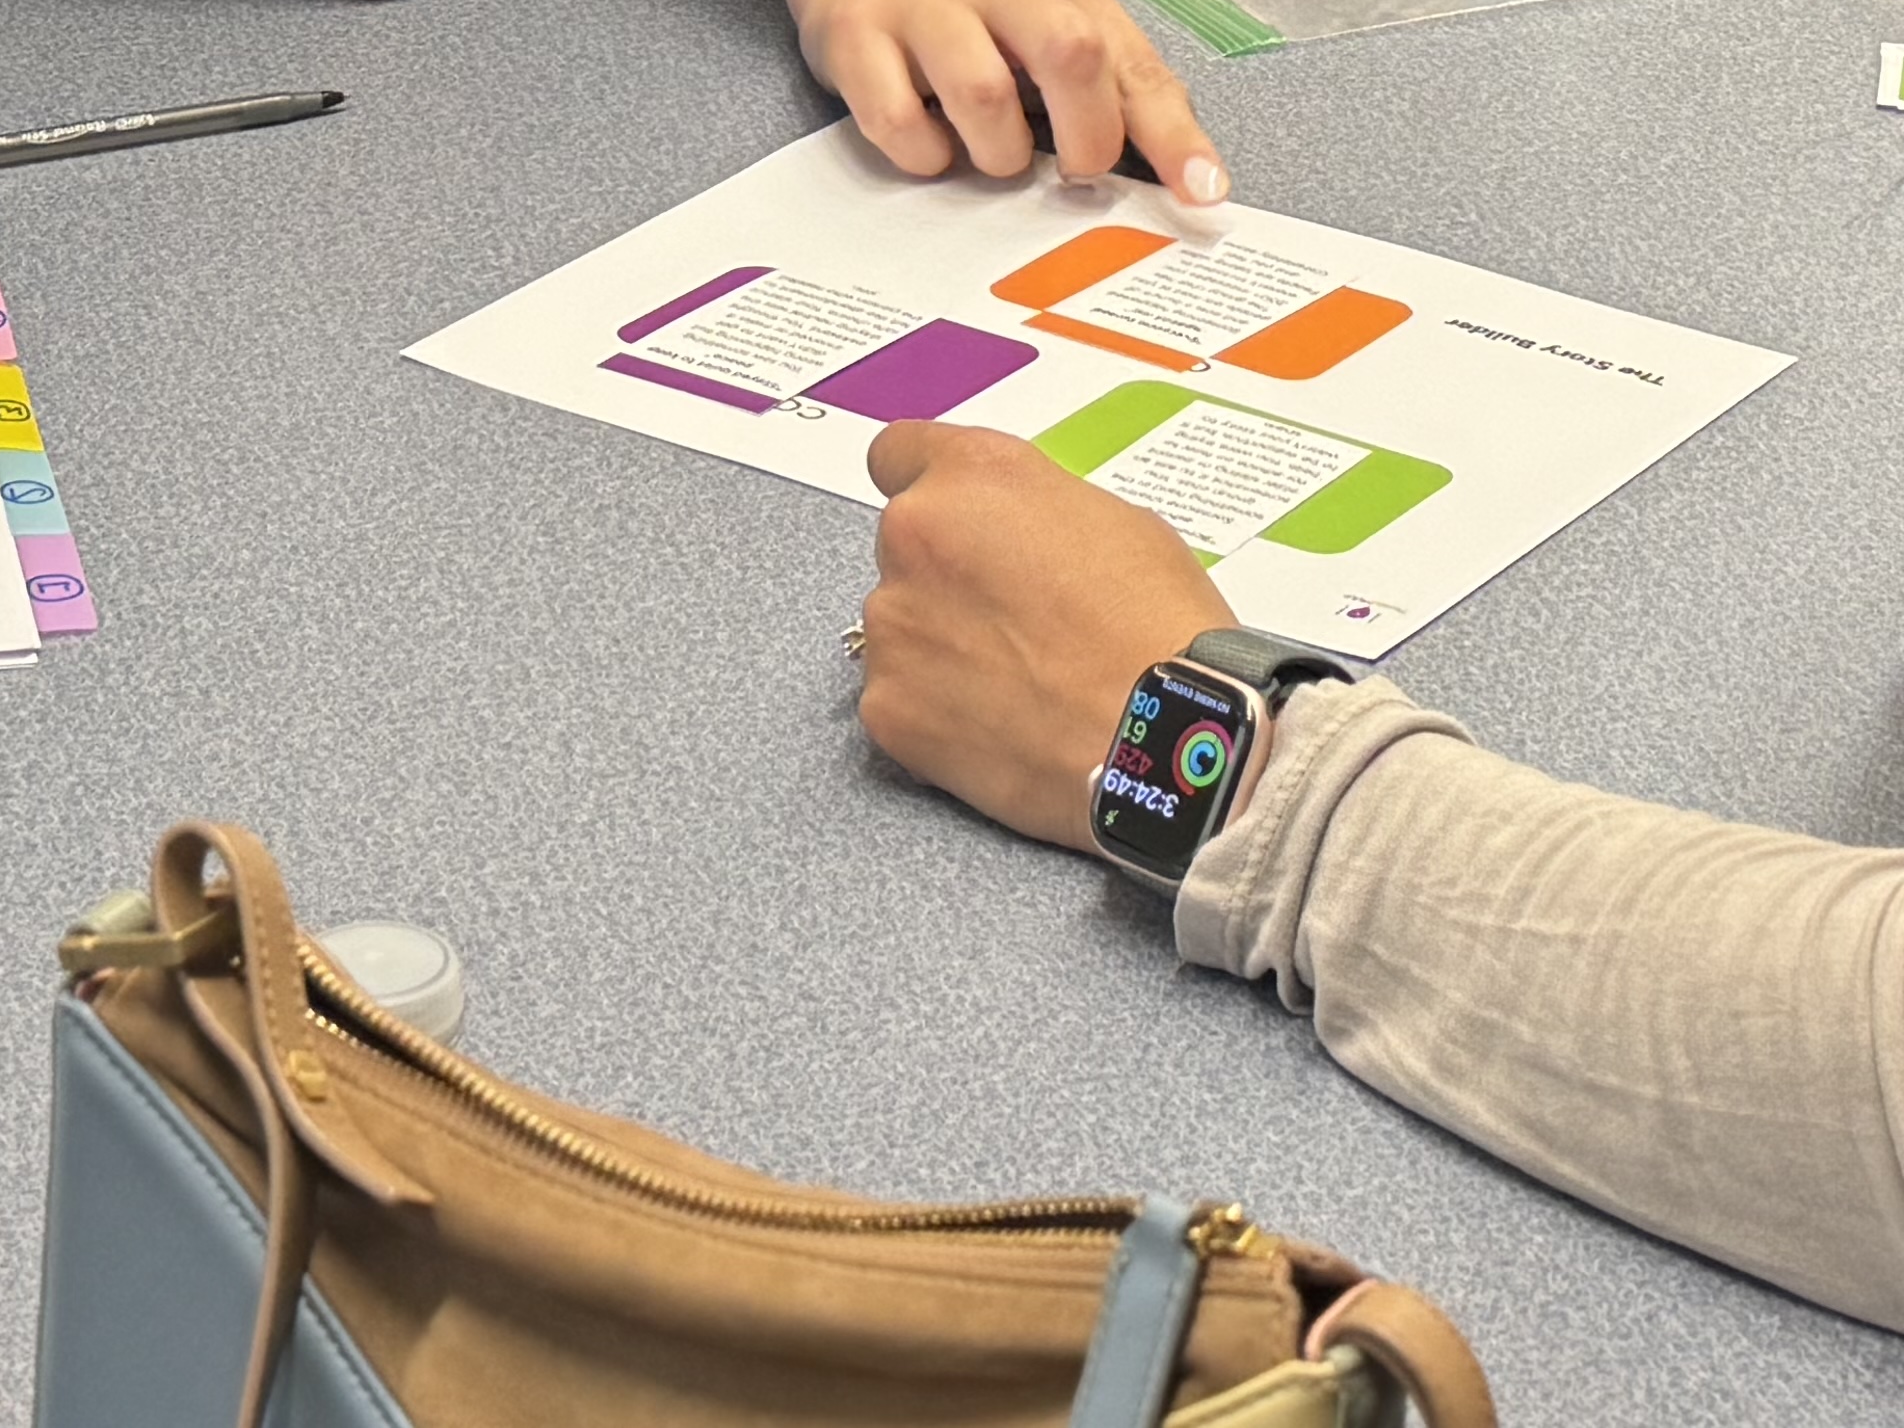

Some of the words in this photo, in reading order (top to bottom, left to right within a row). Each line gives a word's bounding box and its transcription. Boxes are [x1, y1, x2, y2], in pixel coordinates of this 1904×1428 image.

[1444, 319, 1537, 350] Builder
[1539, 344, 1614, 371] Story
[1617, 366, 1665, 387] The
[1114, 744, 1153, 774] 429
[1103, 767, 1180, 818] 3:24:49
